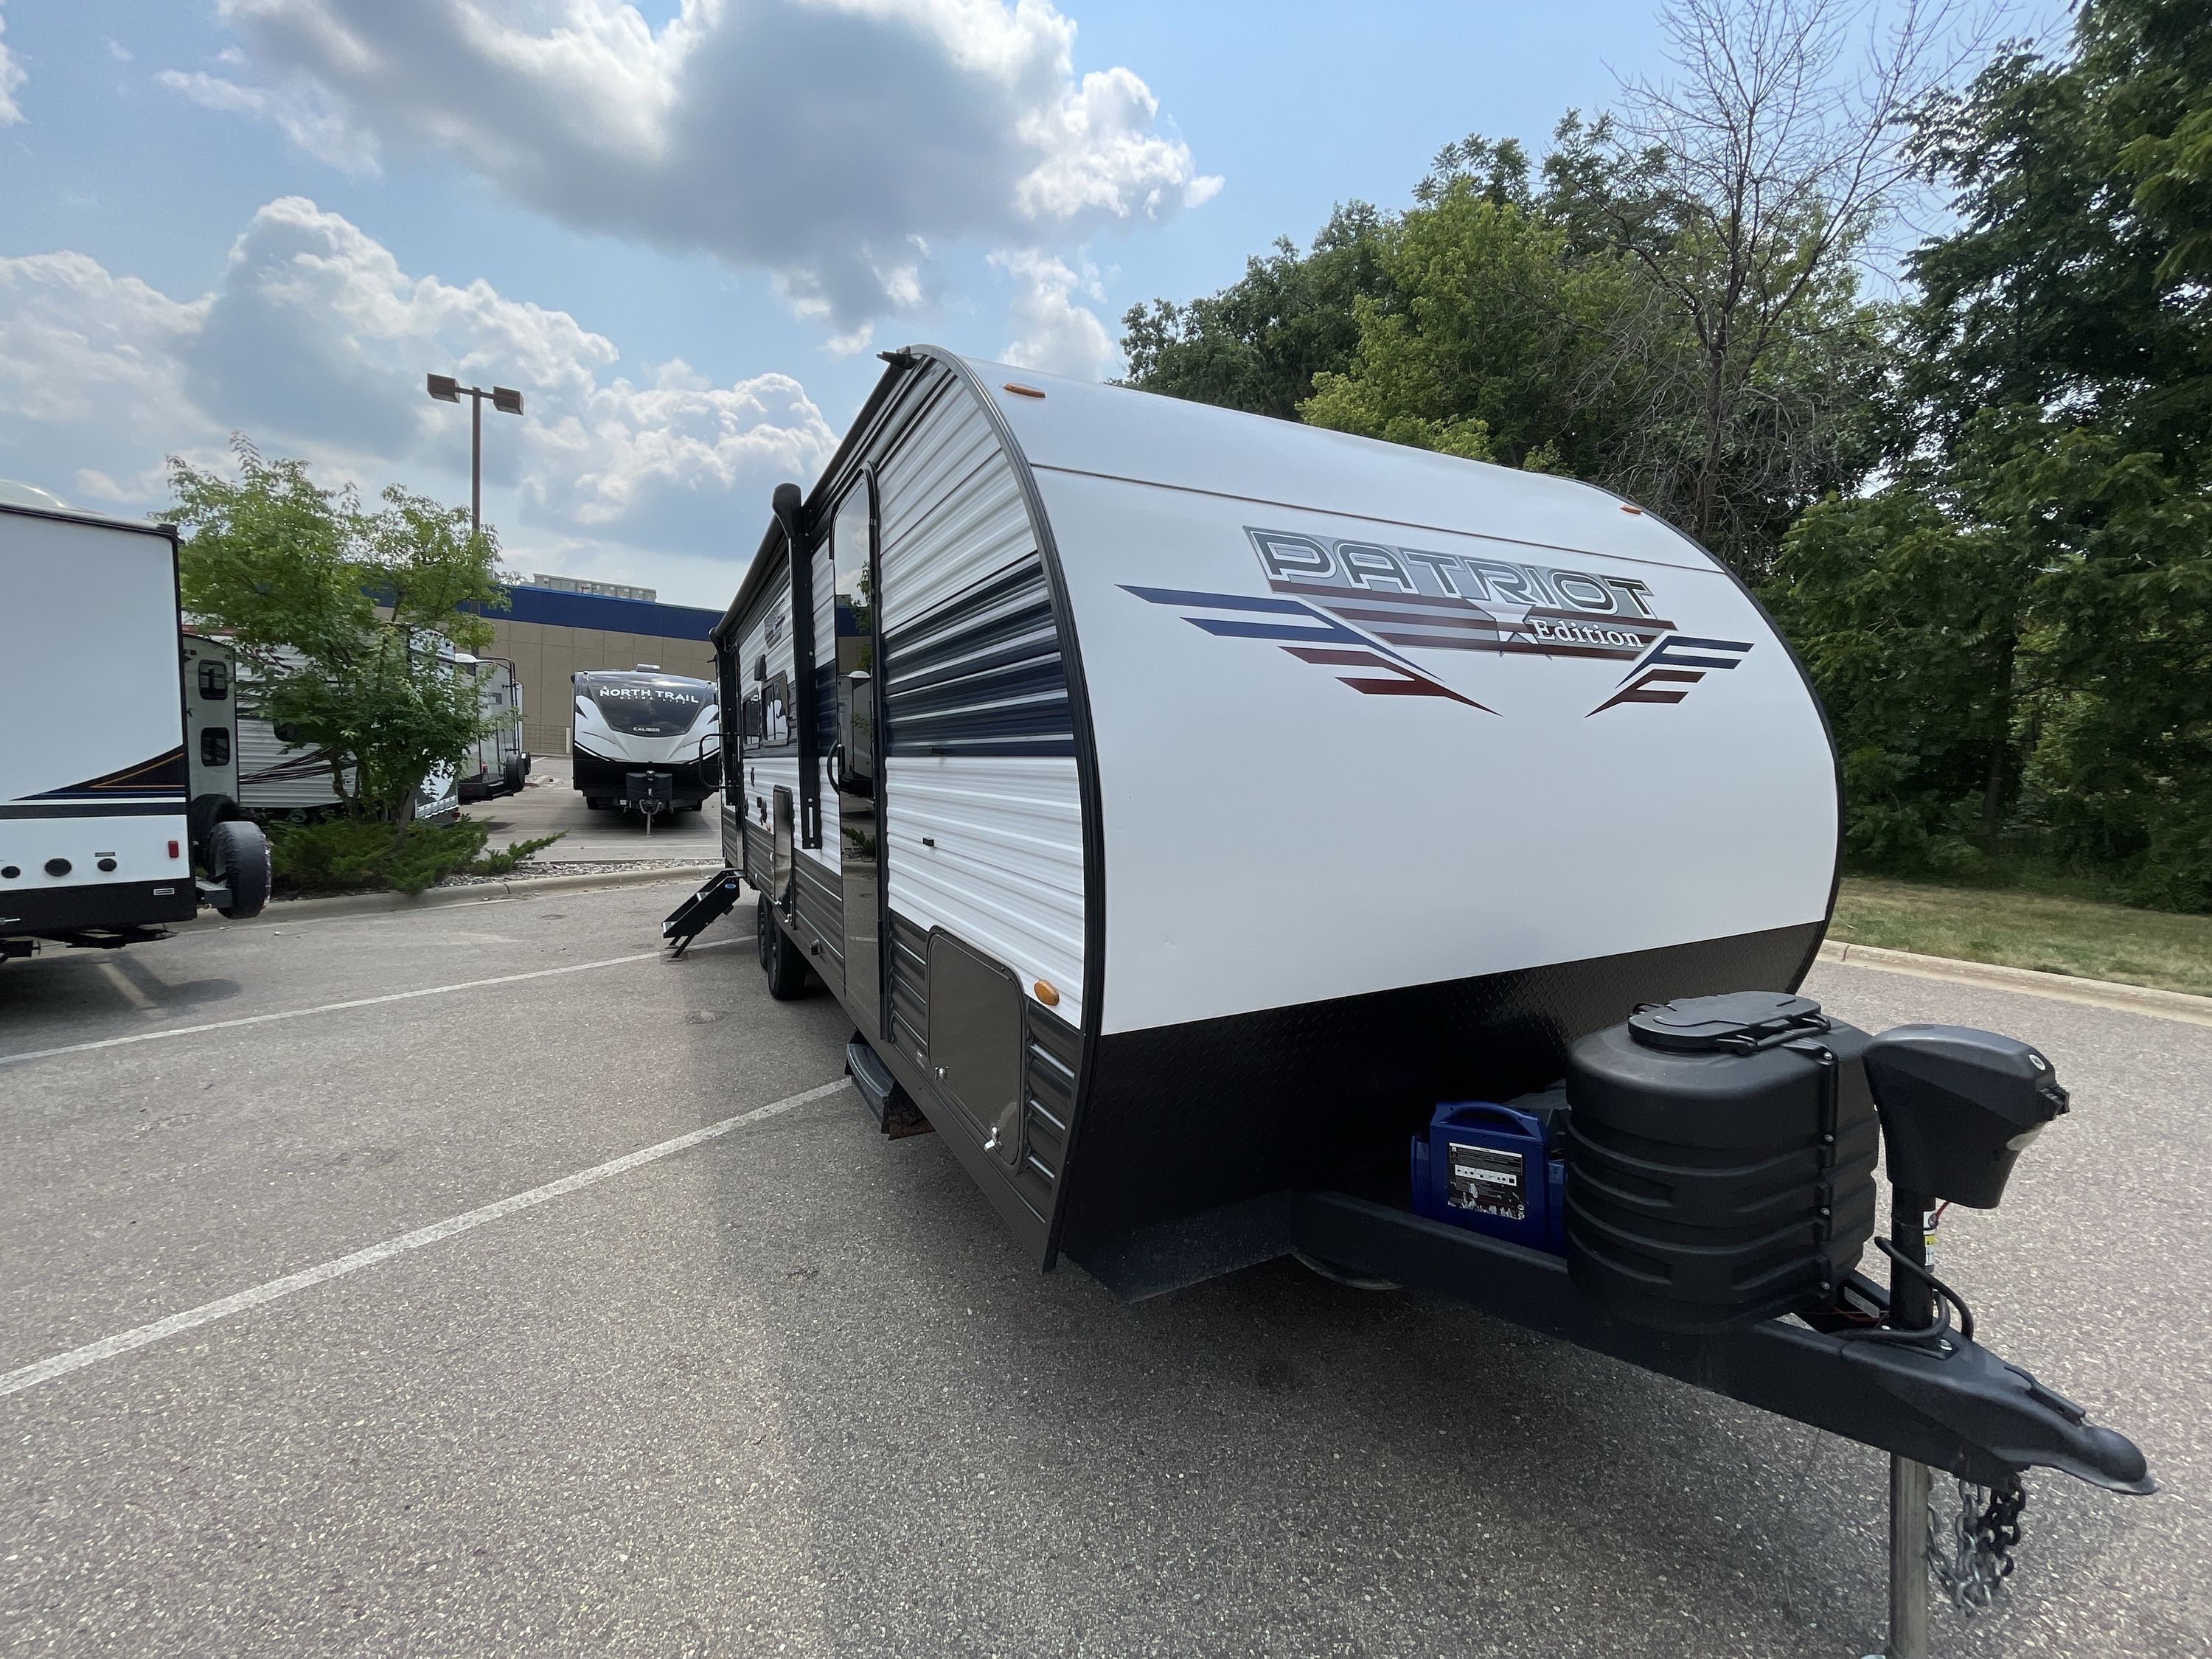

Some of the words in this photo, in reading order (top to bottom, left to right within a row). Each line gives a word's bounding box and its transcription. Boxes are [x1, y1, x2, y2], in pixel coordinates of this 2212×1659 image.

[1249, 529, 1656, 619] PATRIOT
[1530, 619, 1646, 648] Edition
[600, 688, 651, 697] NORTH
[655, 690, 700, 703] TRAIL
